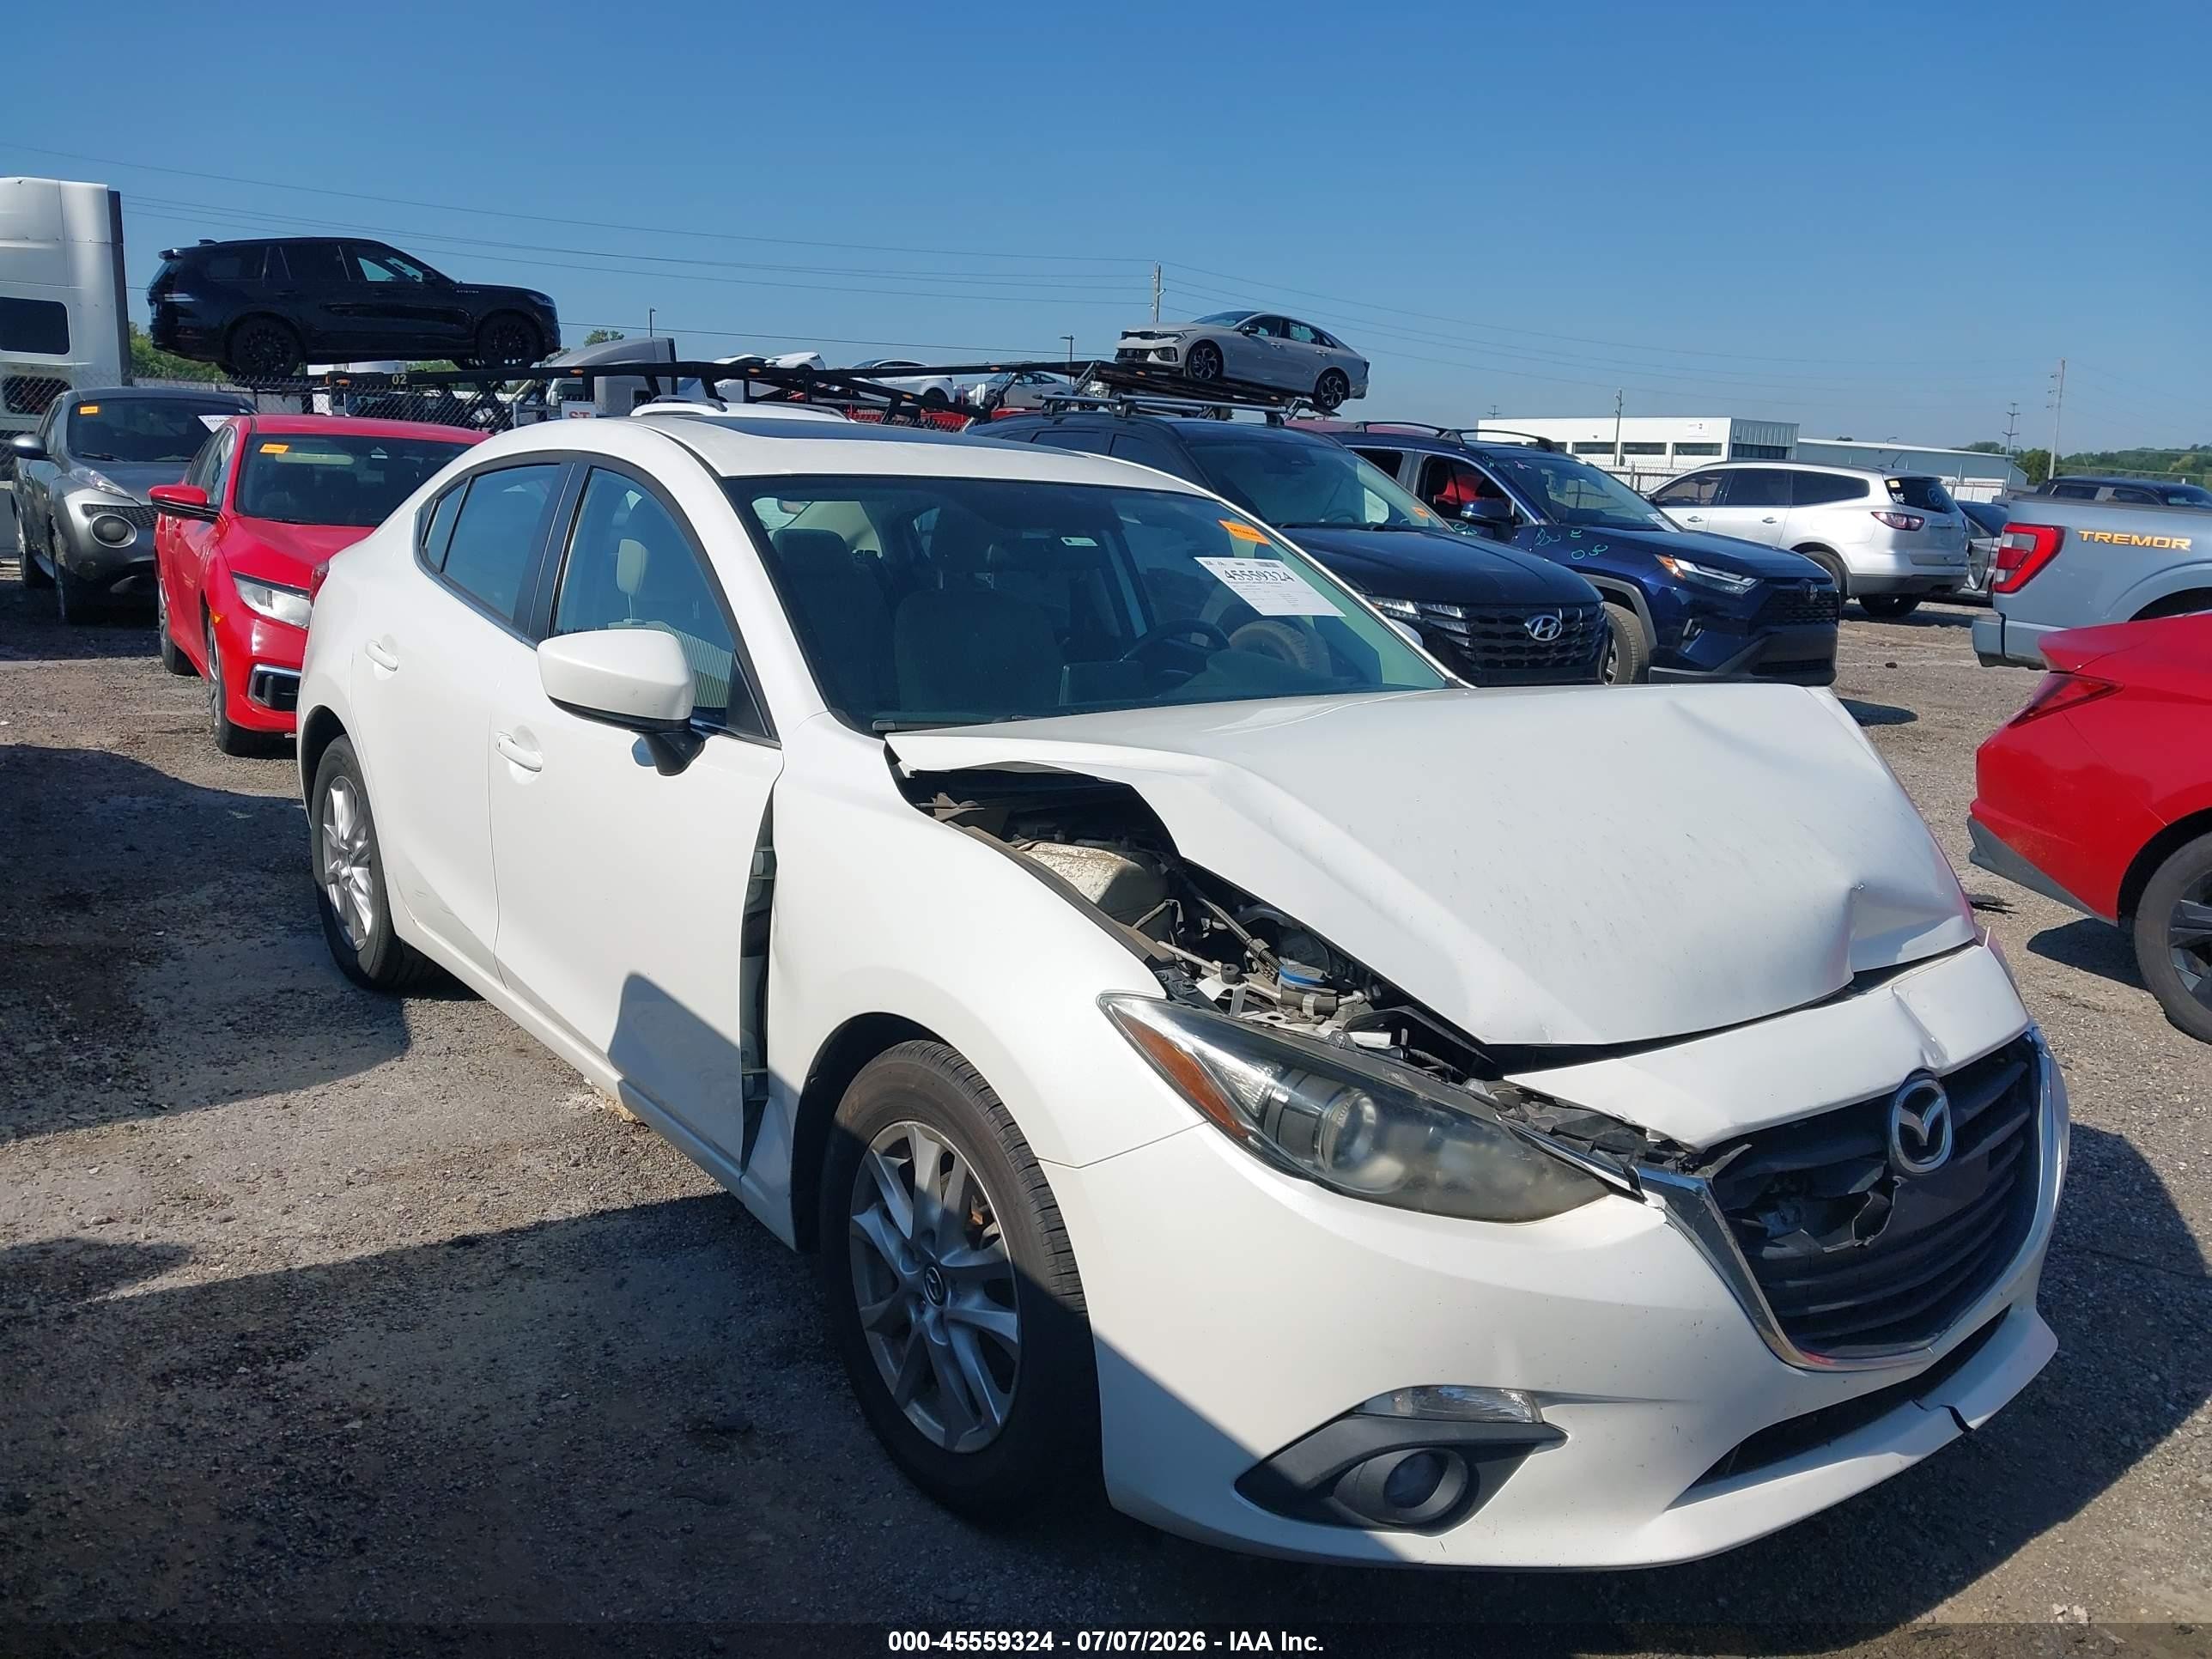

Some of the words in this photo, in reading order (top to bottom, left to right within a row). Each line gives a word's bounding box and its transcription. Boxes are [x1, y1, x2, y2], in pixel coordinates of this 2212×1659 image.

[392, 374, 407, 385] 02
[2078, 530, 2192, 551] TREMOR
[1224, 569, 1295, 582] 45559324
